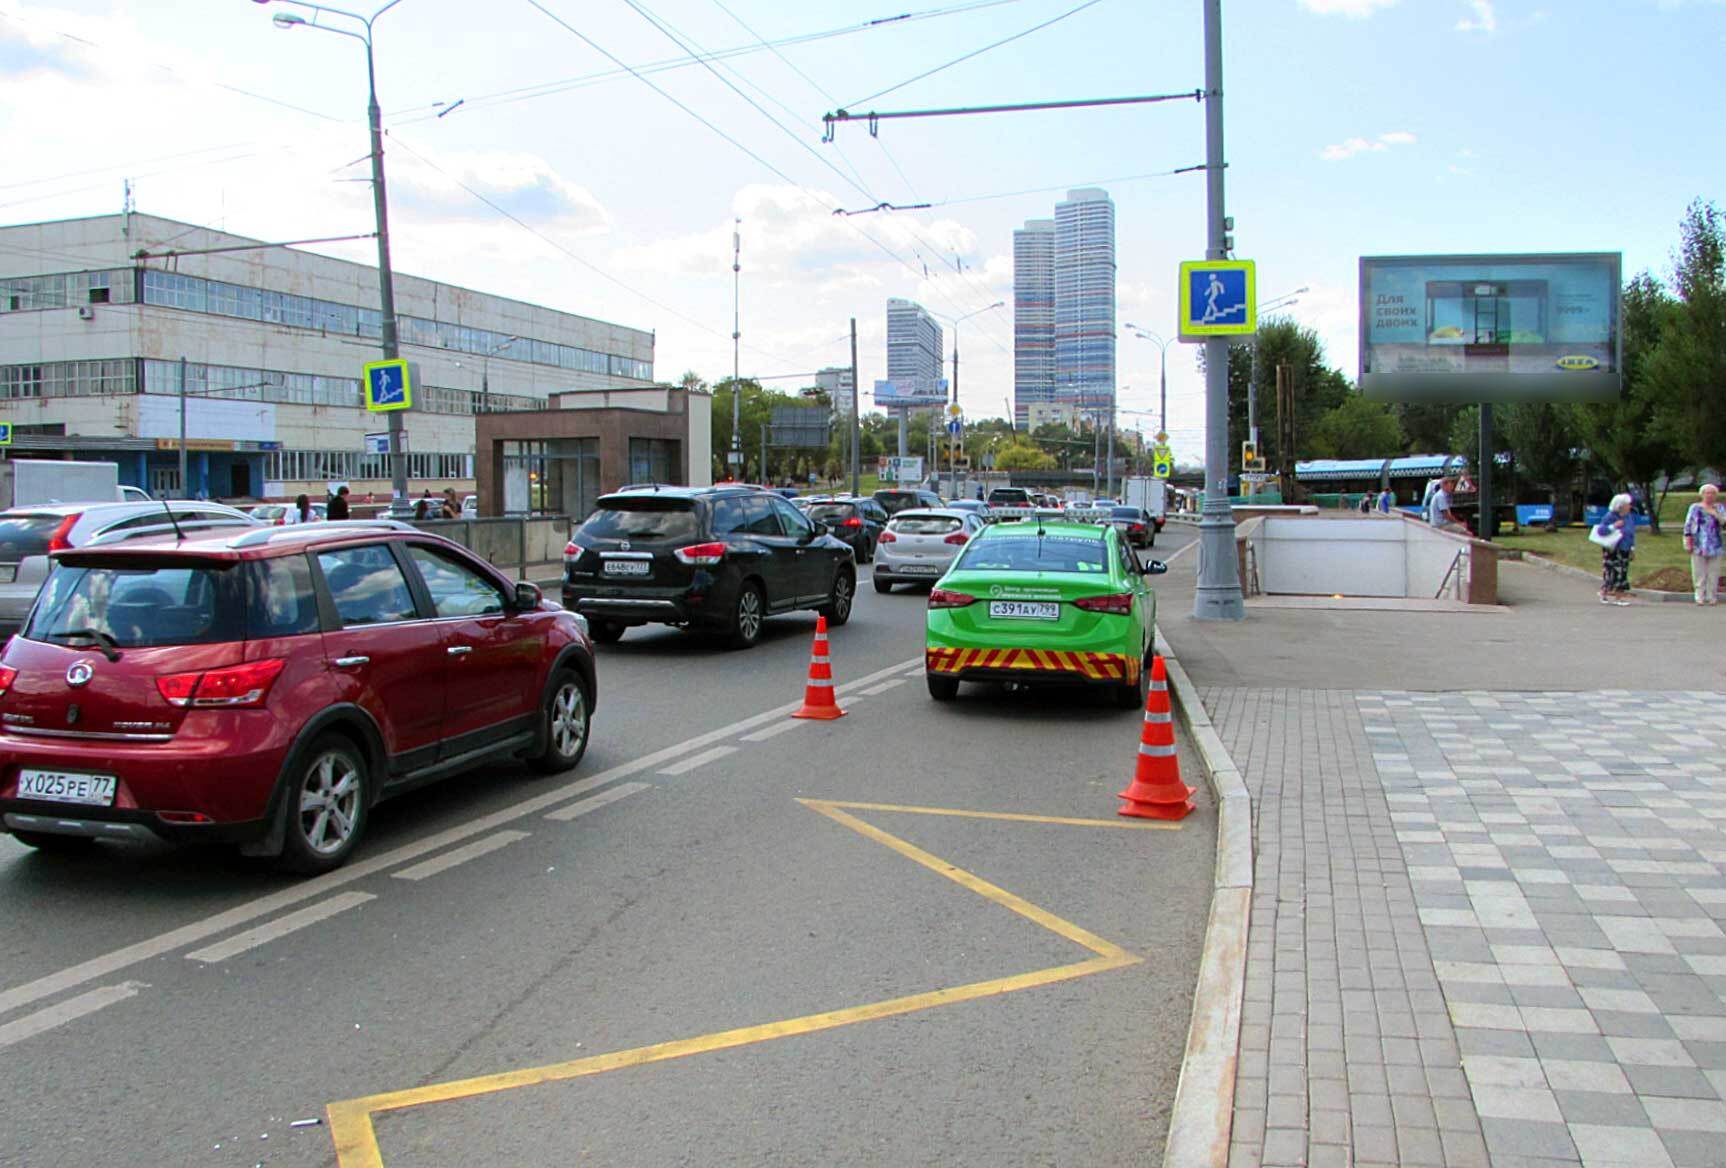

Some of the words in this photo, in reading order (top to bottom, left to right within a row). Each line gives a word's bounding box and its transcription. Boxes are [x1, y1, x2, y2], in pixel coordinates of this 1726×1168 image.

[1376, 293, 1404, 304] Для
[1376, 306, 1417, 316] своих
[1376, 318, 1418, 328] двоих
[994, 603, 1037, 615] С391АУ
[1040, 604, 1057, 613] 799
[24, 773, 88, 798] Х025РЕ
[93, 778, 111, 794] 77
